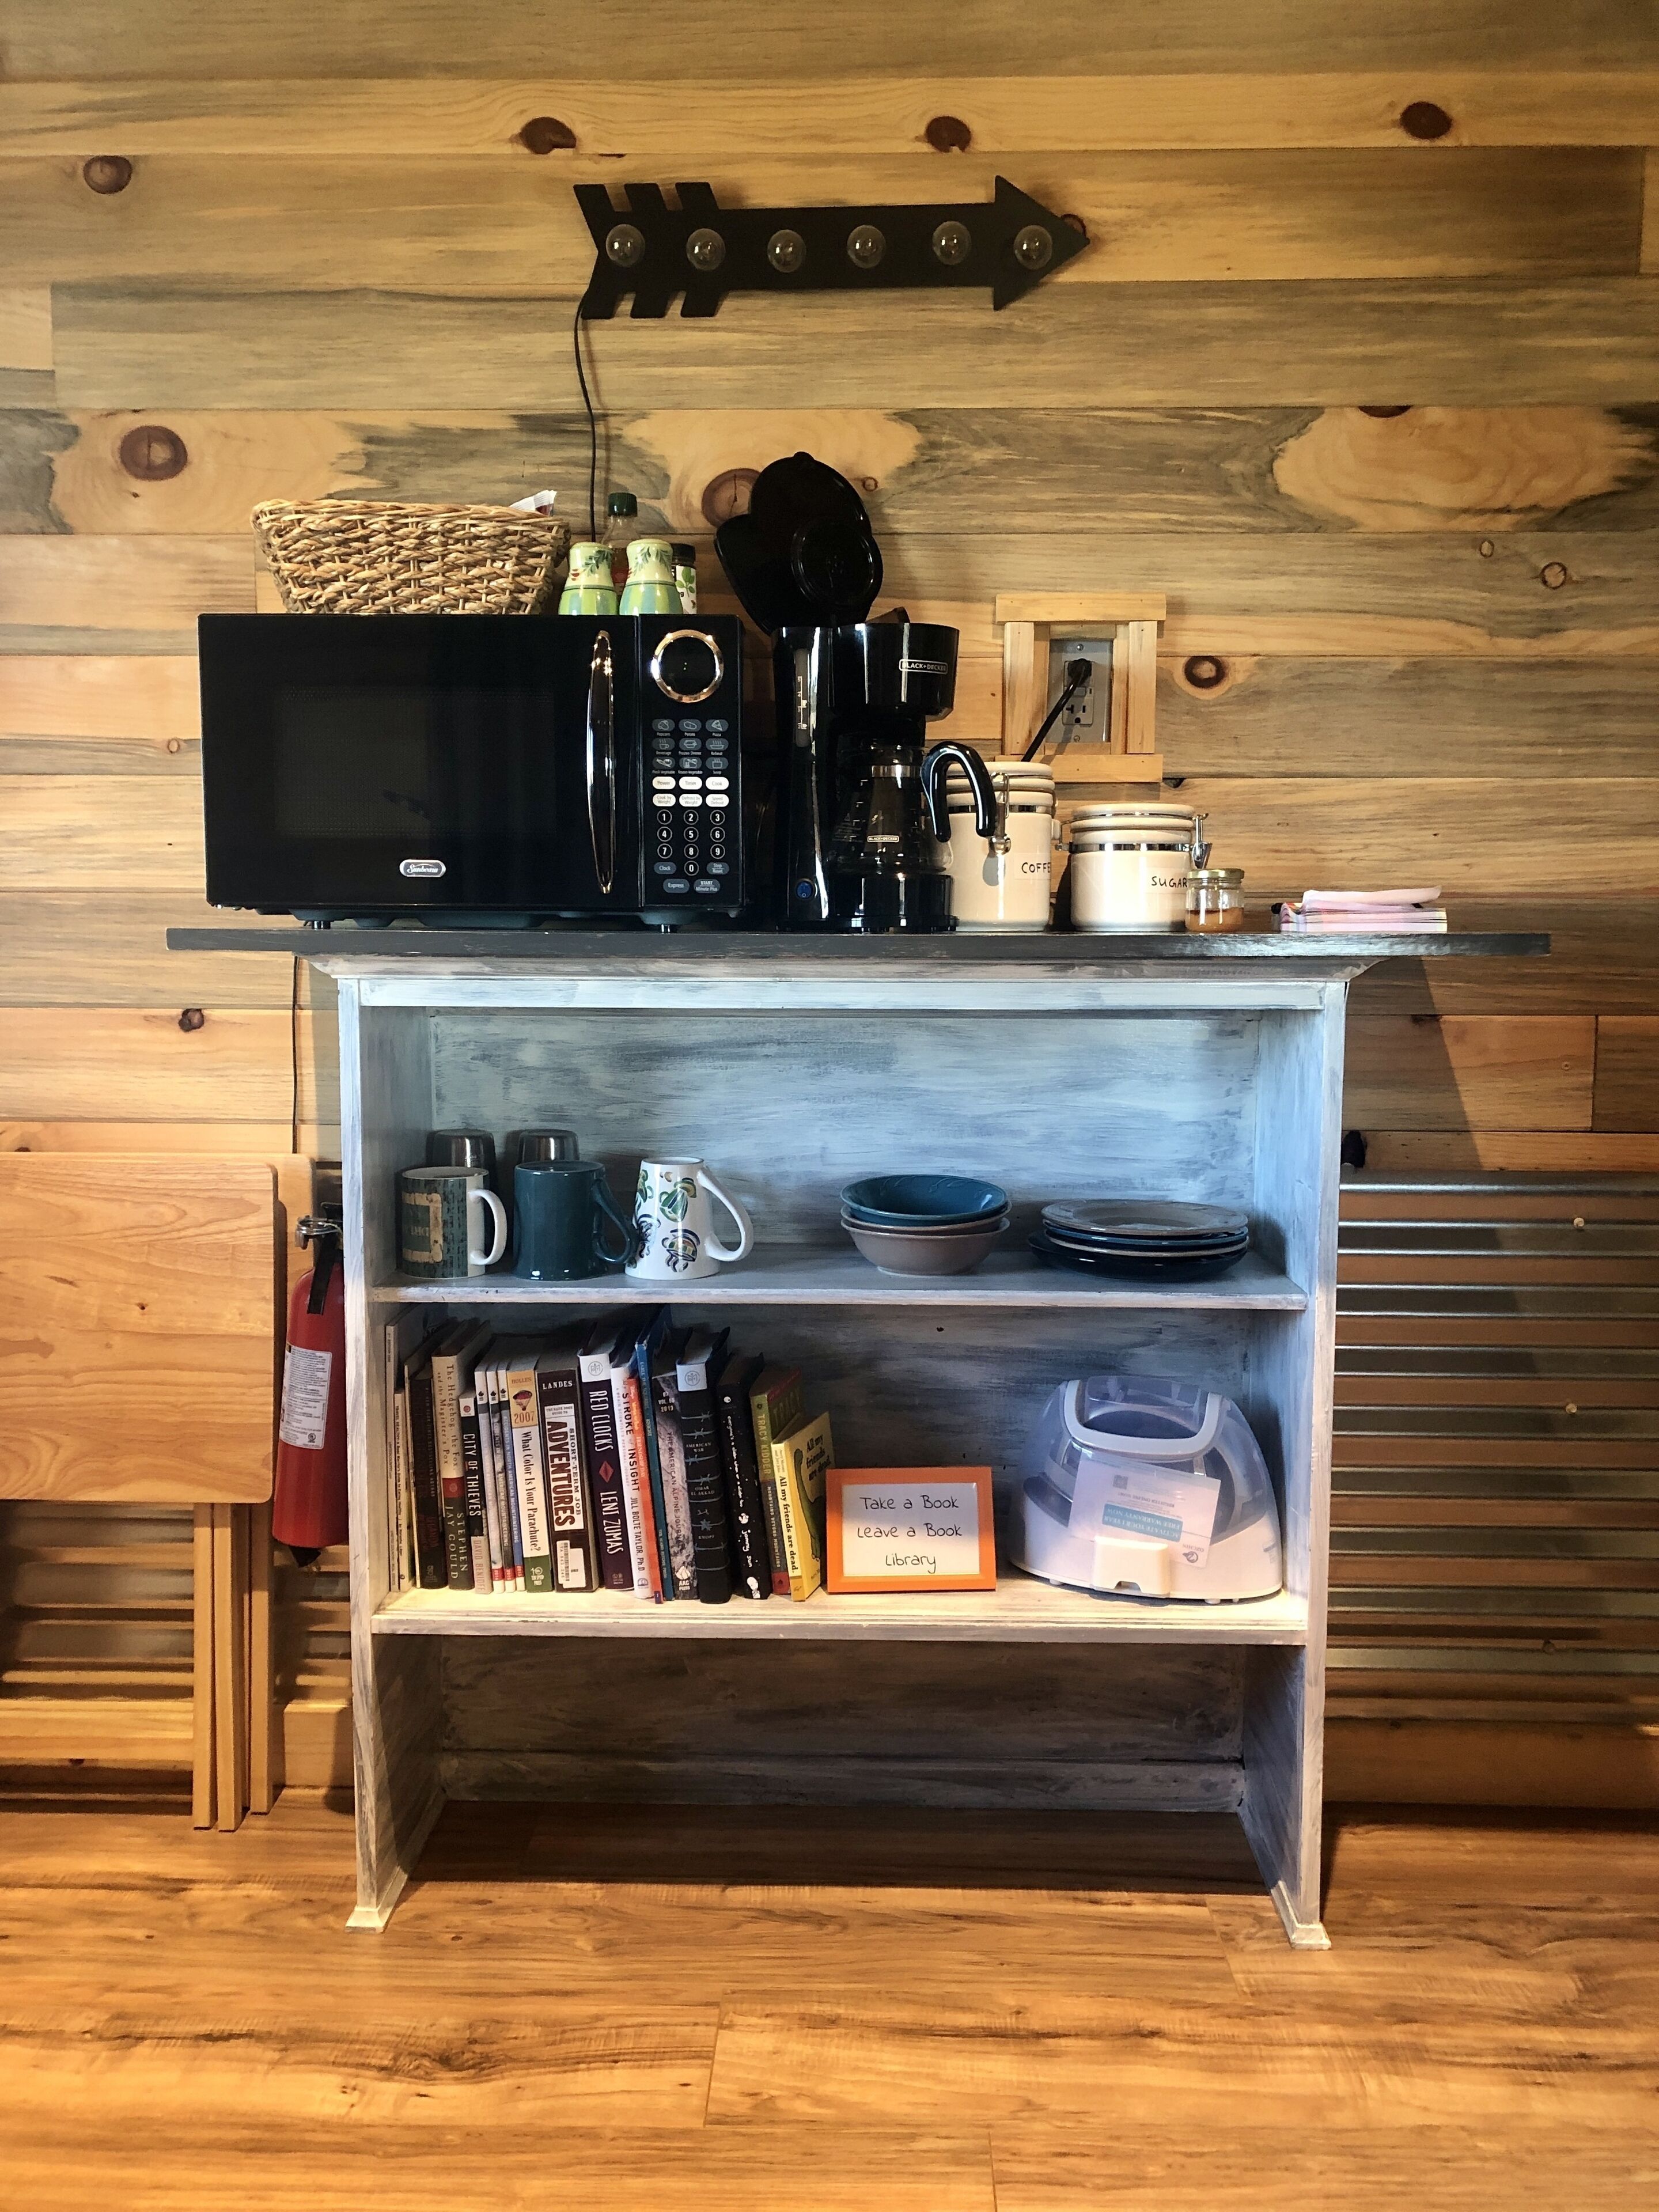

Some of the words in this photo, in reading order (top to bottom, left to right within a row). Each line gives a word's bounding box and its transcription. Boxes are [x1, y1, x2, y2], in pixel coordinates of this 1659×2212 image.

[902, 662, 946, 672] BLACK+DECKER
[662, 813, 666, 821] 1
[688, 813, 694, 821] 2
[715, 831, 720, 839] 6
[662, 847, 667, 855] 7
[689, 847, 694, 855] 8
[715, 848, 720, 856] 9
[407, 864, 438, 874] Sunbeam
[1152, 876, 1188, 888] SUGAR
[446, 1365, 455, 1380] The
[543, 1380, 573, 1390] LANDES
[589, 1390, 609, 1411] RED
[439, 1399, 448, 1445] Magister's
[514, 1411, 535, 1424] 2007
[757, 1414, 767, 1441] TRACY
[521, 1431, 532, 1452] What
[592, 1414, 613, 1452] CLOCKS
[622, 1393, 634, 1435] STROKE
[628, 1448, 640, 1492] INSIGHT
[463, 1434, 476, 1456] CITY
[636, 1436, 645, 1466] FRIENDSHIP
[469, 1460, 478, 1471] OF
[524, 1455, 533, 1475] Color
[570, 1428, 579, 1494] SHORT-TERM
[761, 1444, 771, 1475] KIDDER
[547, 1422, 575, 1527] ADVENTURES
[467, 1475, 481, 1516] THIEVES
[497, 1473, 505, 1500] AMERICAN
[526, 1487, 536, 1505] Your
[780, 1489, 789, 1502] my
[600, 1491, 619, 1515] LENI
[671, 1487, 679, 1513] ALPINE
[859, 1497, 896, 1510] Take
[903, 1498, 913, 1509] a
[920, 1495, 959, 1509] Book
[445, 1506, 455, 1527] JAY
[510, 1498, 519, 1543] MOUNTAINEERING
[632, 1511, 641, 1529] BOLTE
[782, 1503, 793, 1533] friends
[1108, 1508, 1123, 1517] NOW
[1125, 1512, 1161, 1525] WARRANTY
[500, 1501, 509, 1547] MOUNTAINEERING
[530, 1508, 541, 1551] Parachute?
[857, 1527, 899, 1538] Leave
[906, 1527, 916, 1537] a
[923, 1522, 963, 1537] Book
[1147, 1525, 1179, 1538] ACTIVATE
[1162, 1520, 1180, 1530] FREE
[457, 1513, 468, 1571] STEPHEN
[603, 1519, 624, 1554] ZUMAS
[742, 1529, 751, 1551] jomny
[448, 1534, 459, 1579] GOULD
[473, 1540, 483, 1560] DAVID
[789, 1550, 798, 1573] dead.
[885, 1553, 936, 1574] Library
